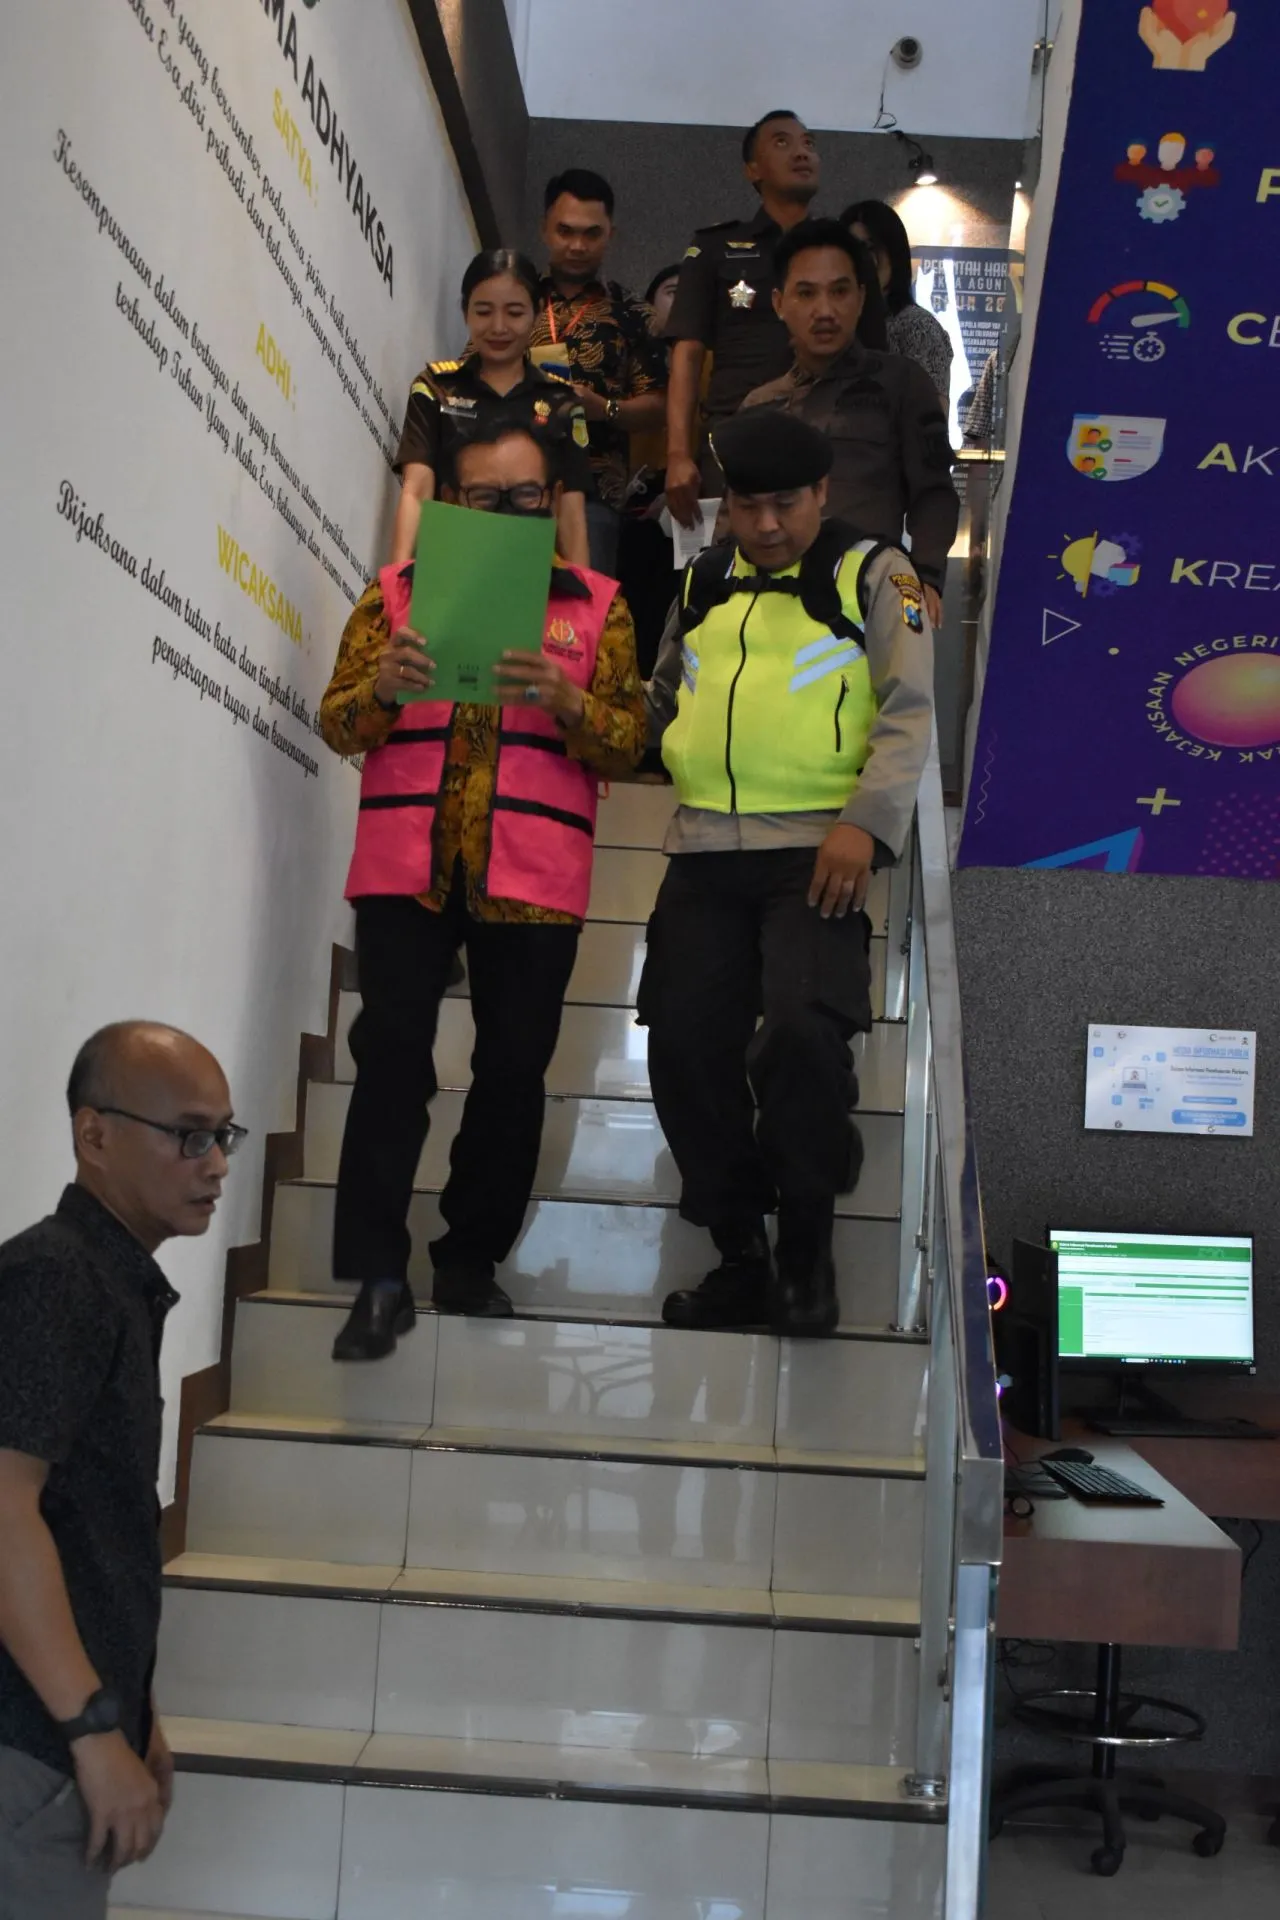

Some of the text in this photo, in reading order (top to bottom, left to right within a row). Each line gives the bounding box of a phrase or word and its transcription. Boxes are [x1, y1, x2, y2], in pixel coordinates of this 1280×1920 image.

[178, 13, 209, 86] yang
[210, 66, 262, 179] bersumber
[262, 174, 286, 227] pada
[287, 219, 305, 265] rasa
[329, 294, 345, 338] baik
[345, 326, 373, 394] terhadap
[206, 127, 246, 203] pribadi
[246, 192, 265, 240] dan
[306, 306, 336, 367] maupun
[336, 353, 361, 411] kepada
[301, 54, 393, 300] ADHYAKSA
[968, 277, 1007, 291] AGUN
[53, 128, 152, 289] Kesempurnaan
[153, 273, 190, 341] dalam
[190, 321, 230, 394] bertugas
[230, 380, 248, 421] dan
[249, 411, 270, 456] yang
[300, 483, 322, 521] utama
[115, 280, 169, 374] terhadap
[169, 350, 204, 413] Tuhan
[205, 391, 230, 454] Yang
[231, 431, 259, 482] Maha
[276, 486, 307, 546] keluarga
[307, 528, 322, 561] dan
[56, 479, 138, 578] Bijaksana
[140, 557, 183, 617] dalam
[183, 598, 212, 644] tutur
[213, 621, 237, 665] kata
[238, 645, 258, 683] dan
[257, 664, 292, 706] tingkah
[152, 634, 223, 702] pengetrapan
[223, 684, 251, 727] tugas
[252, 706, 271, 741] dan
[270, 719, 319, 778] kewenangan
[1173, 635, 1279, 667] NEGERI
[1145, 671, 1222, 762] KEJAKSAAN
